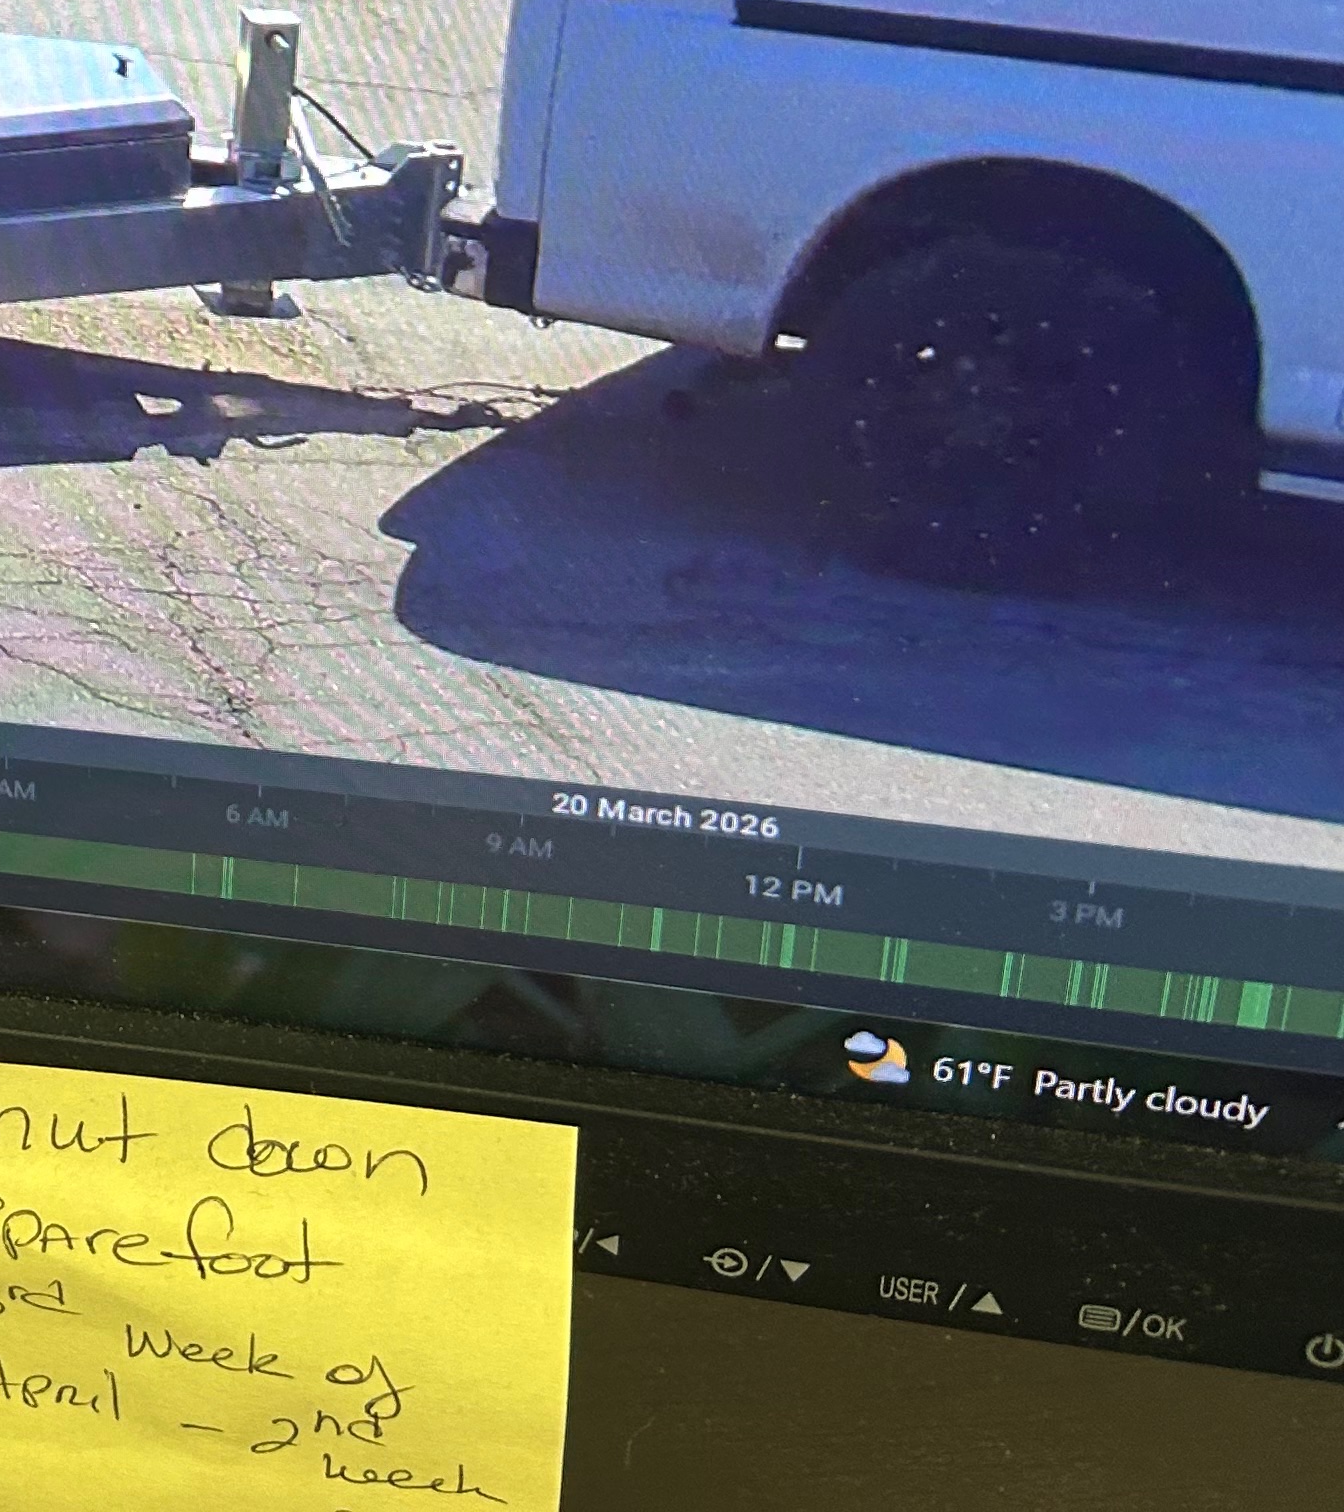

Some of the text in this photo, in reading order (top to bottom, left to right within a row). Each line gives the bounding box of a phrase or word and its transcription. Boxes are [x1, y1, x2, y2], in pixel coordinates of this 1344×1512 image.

[226, 803, 289, 828] 6 AM
[552, 792, 780, 839] 20 March 2026
[486, 832, 552, 859] 9 AM
[745, 873, 845, 907] 12 PM
[1050, 901, 1125, 930] 3 PM
[932, 1056, 1271, 1129] 61°F Partly cloudy
[879, 1275, 939, 1306] USER
